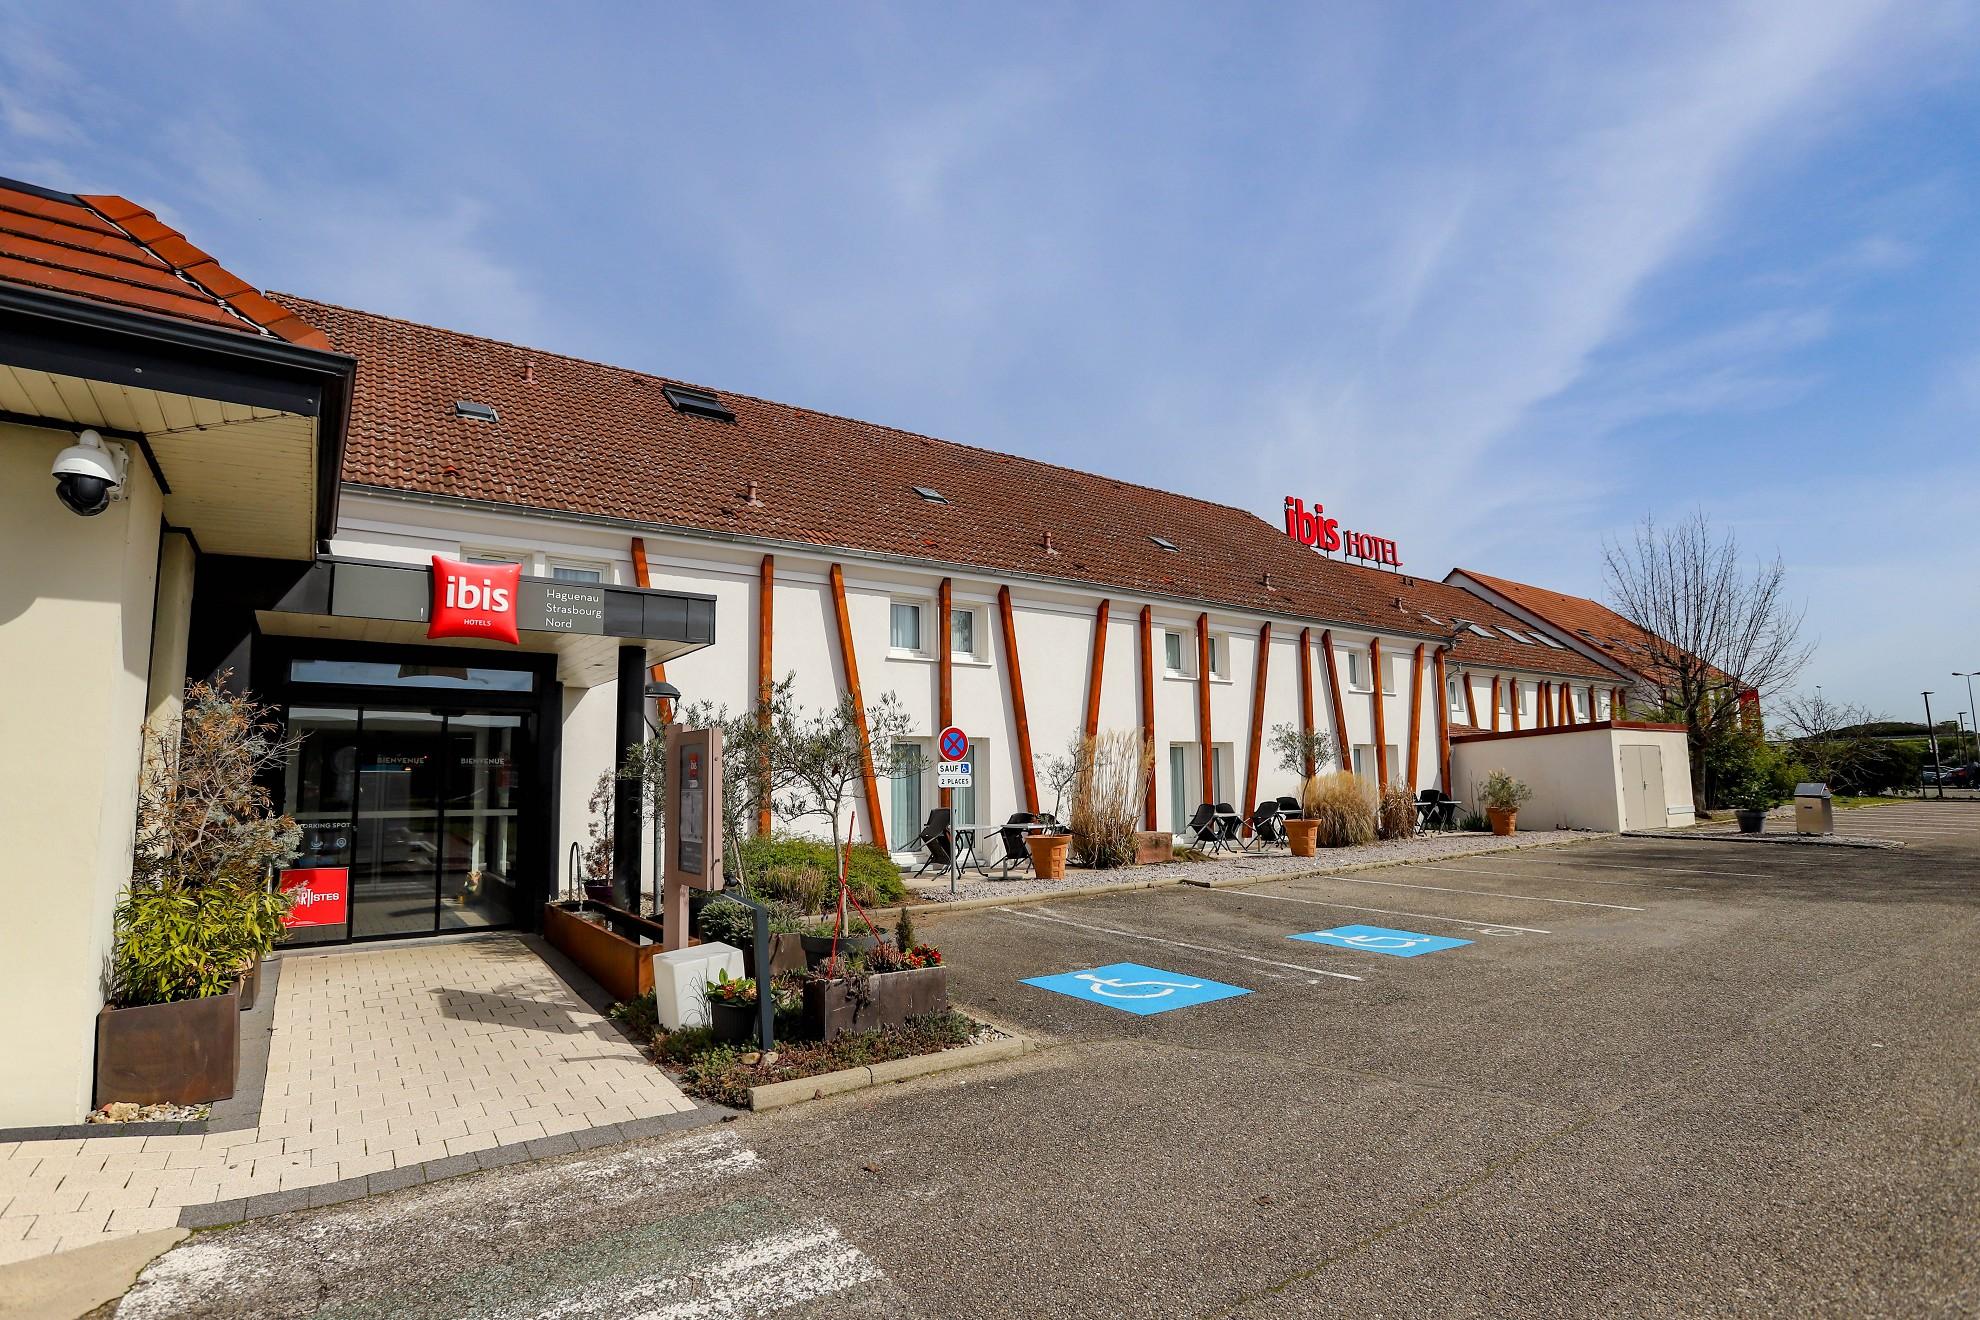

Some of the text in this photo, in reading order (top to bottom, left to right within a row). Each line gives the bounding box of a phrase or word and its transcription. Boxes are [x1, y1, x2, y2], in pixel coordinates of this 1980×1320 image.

[1284, 496, 1404, 567] ibis HOTEL
[446, 575, 509, 612] ibis
[546, 588, 599, 602] Haguenau
[546, 602, 602, 619] Strasbourg
[463, 618, 492, 627] HOTELS
[545, 617, 572, 628] Nord
[377, 757, 425, 765] BIENVENUE
[460, 758, 505, 766] BIENVENUE
[939, 764, 959, 773] SAUF
